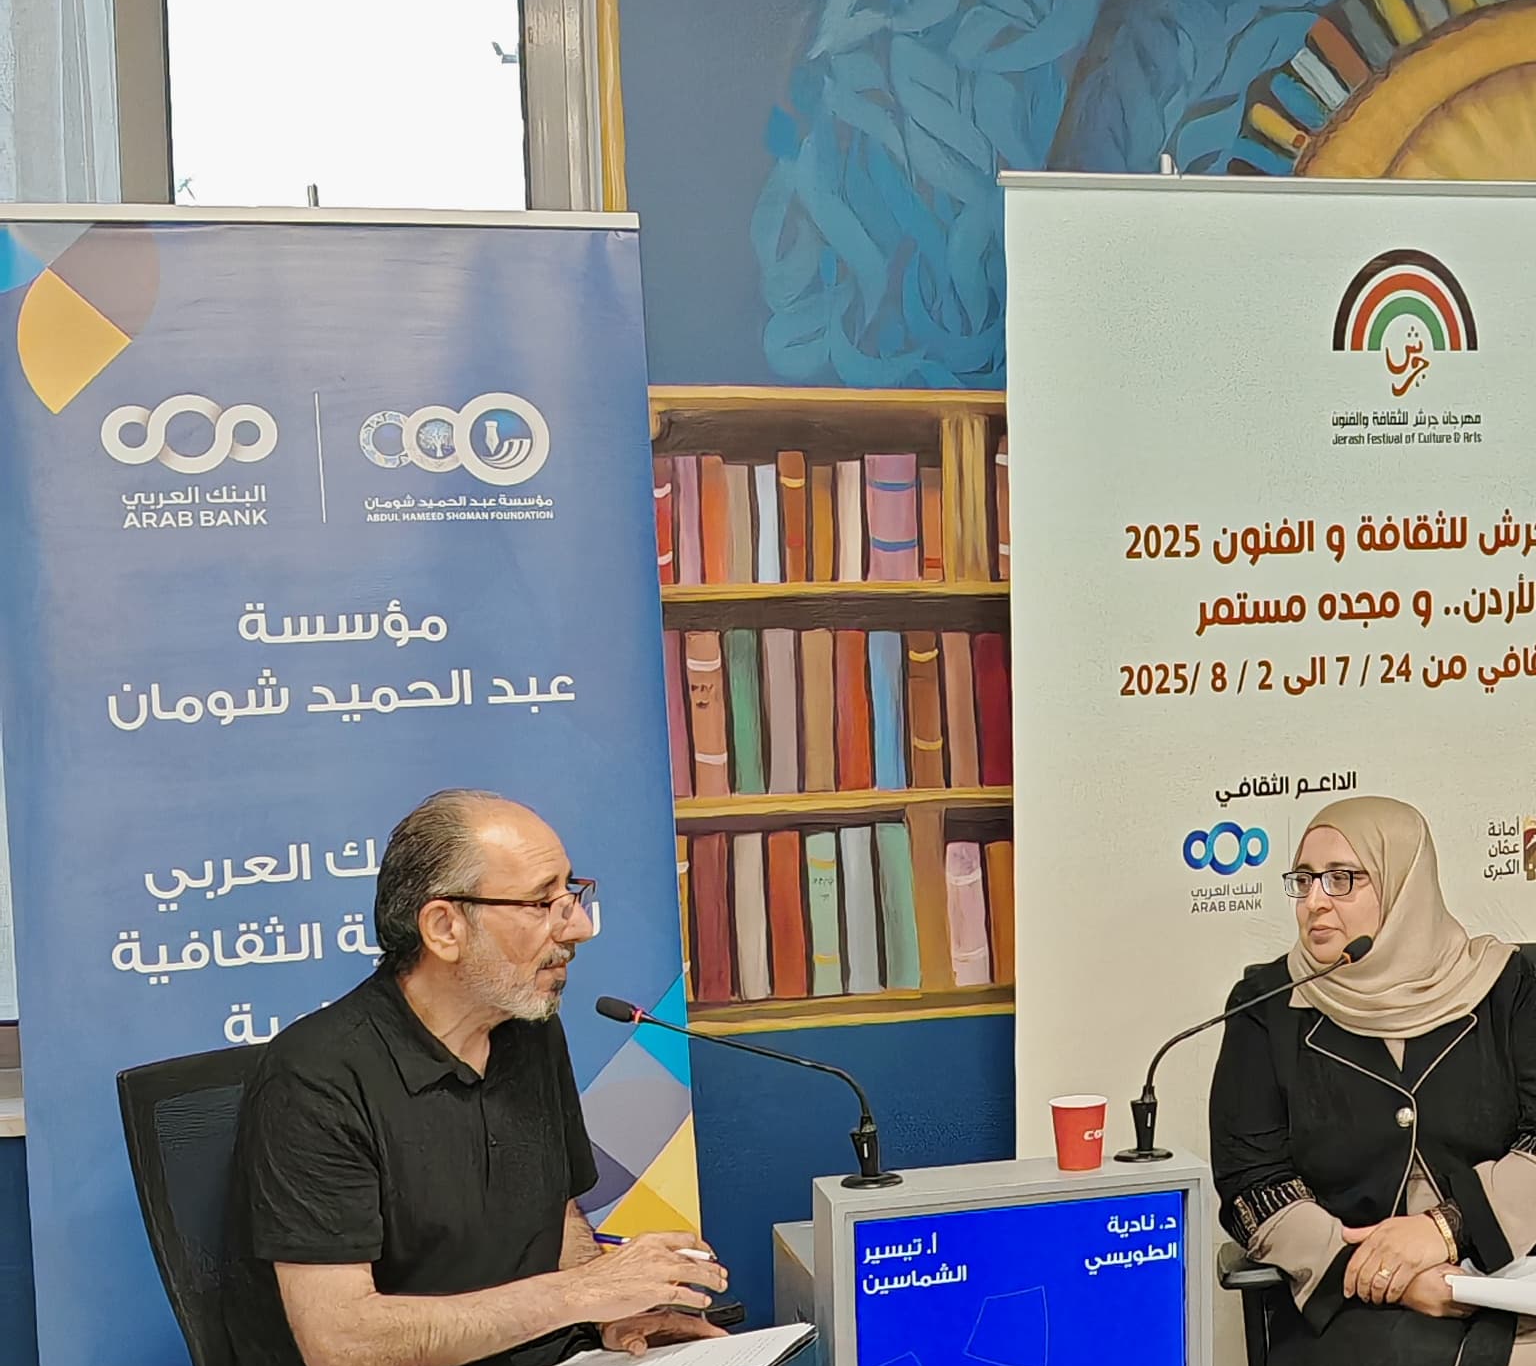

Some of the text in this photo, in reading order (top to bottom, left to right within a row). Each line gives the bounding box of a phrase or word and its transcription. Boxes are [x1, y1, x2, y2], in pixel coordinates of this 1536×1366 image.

[1332, 408, 1482, 430] مهرجان جرش للثقافة والفنون
[1332, 433, 1365, 445] Jerash
[1367, 432, 1402, 445] Festival
[1405, 432, 1415, 444] of
[1418, 432, 1452, 444] Culture
[1464, 432, 1482, 443] Arts
[121, 484, 267, 510] البنك العربي
[364, 493, 554, 511] مؤسسة عبد الحميد شومان
[123, 509, 268, 529] ARAB BANK
[366, 510, 555, 523] ABDUL HAMEED SHOMAN FOUNDATION
[1125, 524, 1201, 560] 2025
[1212, 516, 1314, 565] الفنون
[1326, 530, 1345, 562] و
[1357, 509, 1468, 556] للثقافة
[238, 599, 448, 647] مؤسسة
[1196, 594, 1307, 636] مستمر
[1318, 591, 1400, 629] مجده
[1412, 593, 1433, 627] و
[1210, 663, 1227, 692] 8
[1257, 661, 1274, 690] 2
[1335, 656, 1351, 687] 7
[1380, 652, 1412, 685] 24
[1423, 657, 1468, 688] من
[107, 668, 576, 731] عبد الحميد شومان
[1215, 773, 1290, 808] الثقافي
[1488, 816, 1520, 837] أمانة
[144, 842, 312, 912] العربي
[1483, 858, 1520, 882] الكبرى
[1191, 883, 1263, 901] البنك العربي
[1191, 898, 1262, 914] ARAB BANK
[110, 916, 323, 985] الثقافية
[1106, 1212, 1177, 1237] د. نادية
[863, 1239, 924, 1265] تيسير
[1084, 1242, 1178, 1275] الطويسي
[862, 1263, 968, 1296] الشماسين
